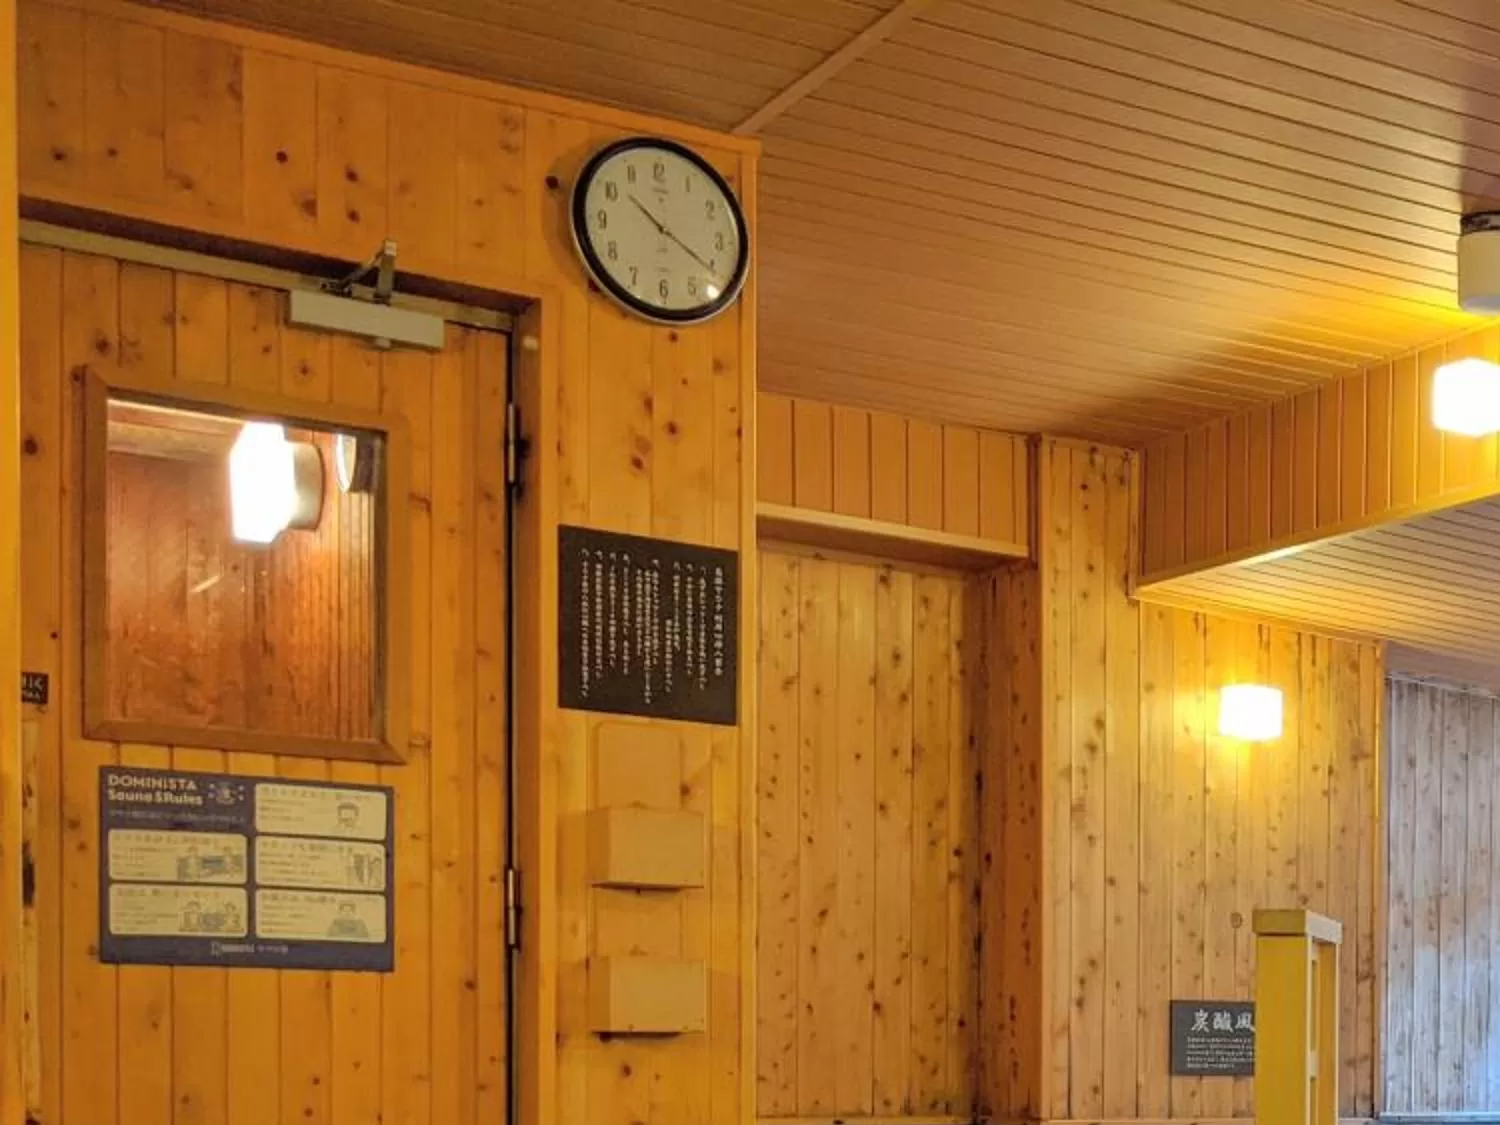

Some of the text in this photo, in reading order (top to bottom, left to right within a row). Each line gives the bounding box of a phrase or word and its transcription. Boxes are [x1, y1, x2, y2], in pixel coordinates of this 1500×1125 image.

[653, 162, 665, 182] 12
[605, 181, 618, 201] 10
[598, 211, 607, 230] 9
[705, 200, 715, 221] 2
[607, 241, 618, 260] 8
[715, 232, 724, 252] 3
[629, 266, 638, 286] 7
[659, 279, 669, 298] 6
[687, 277, 697, 296] 5
